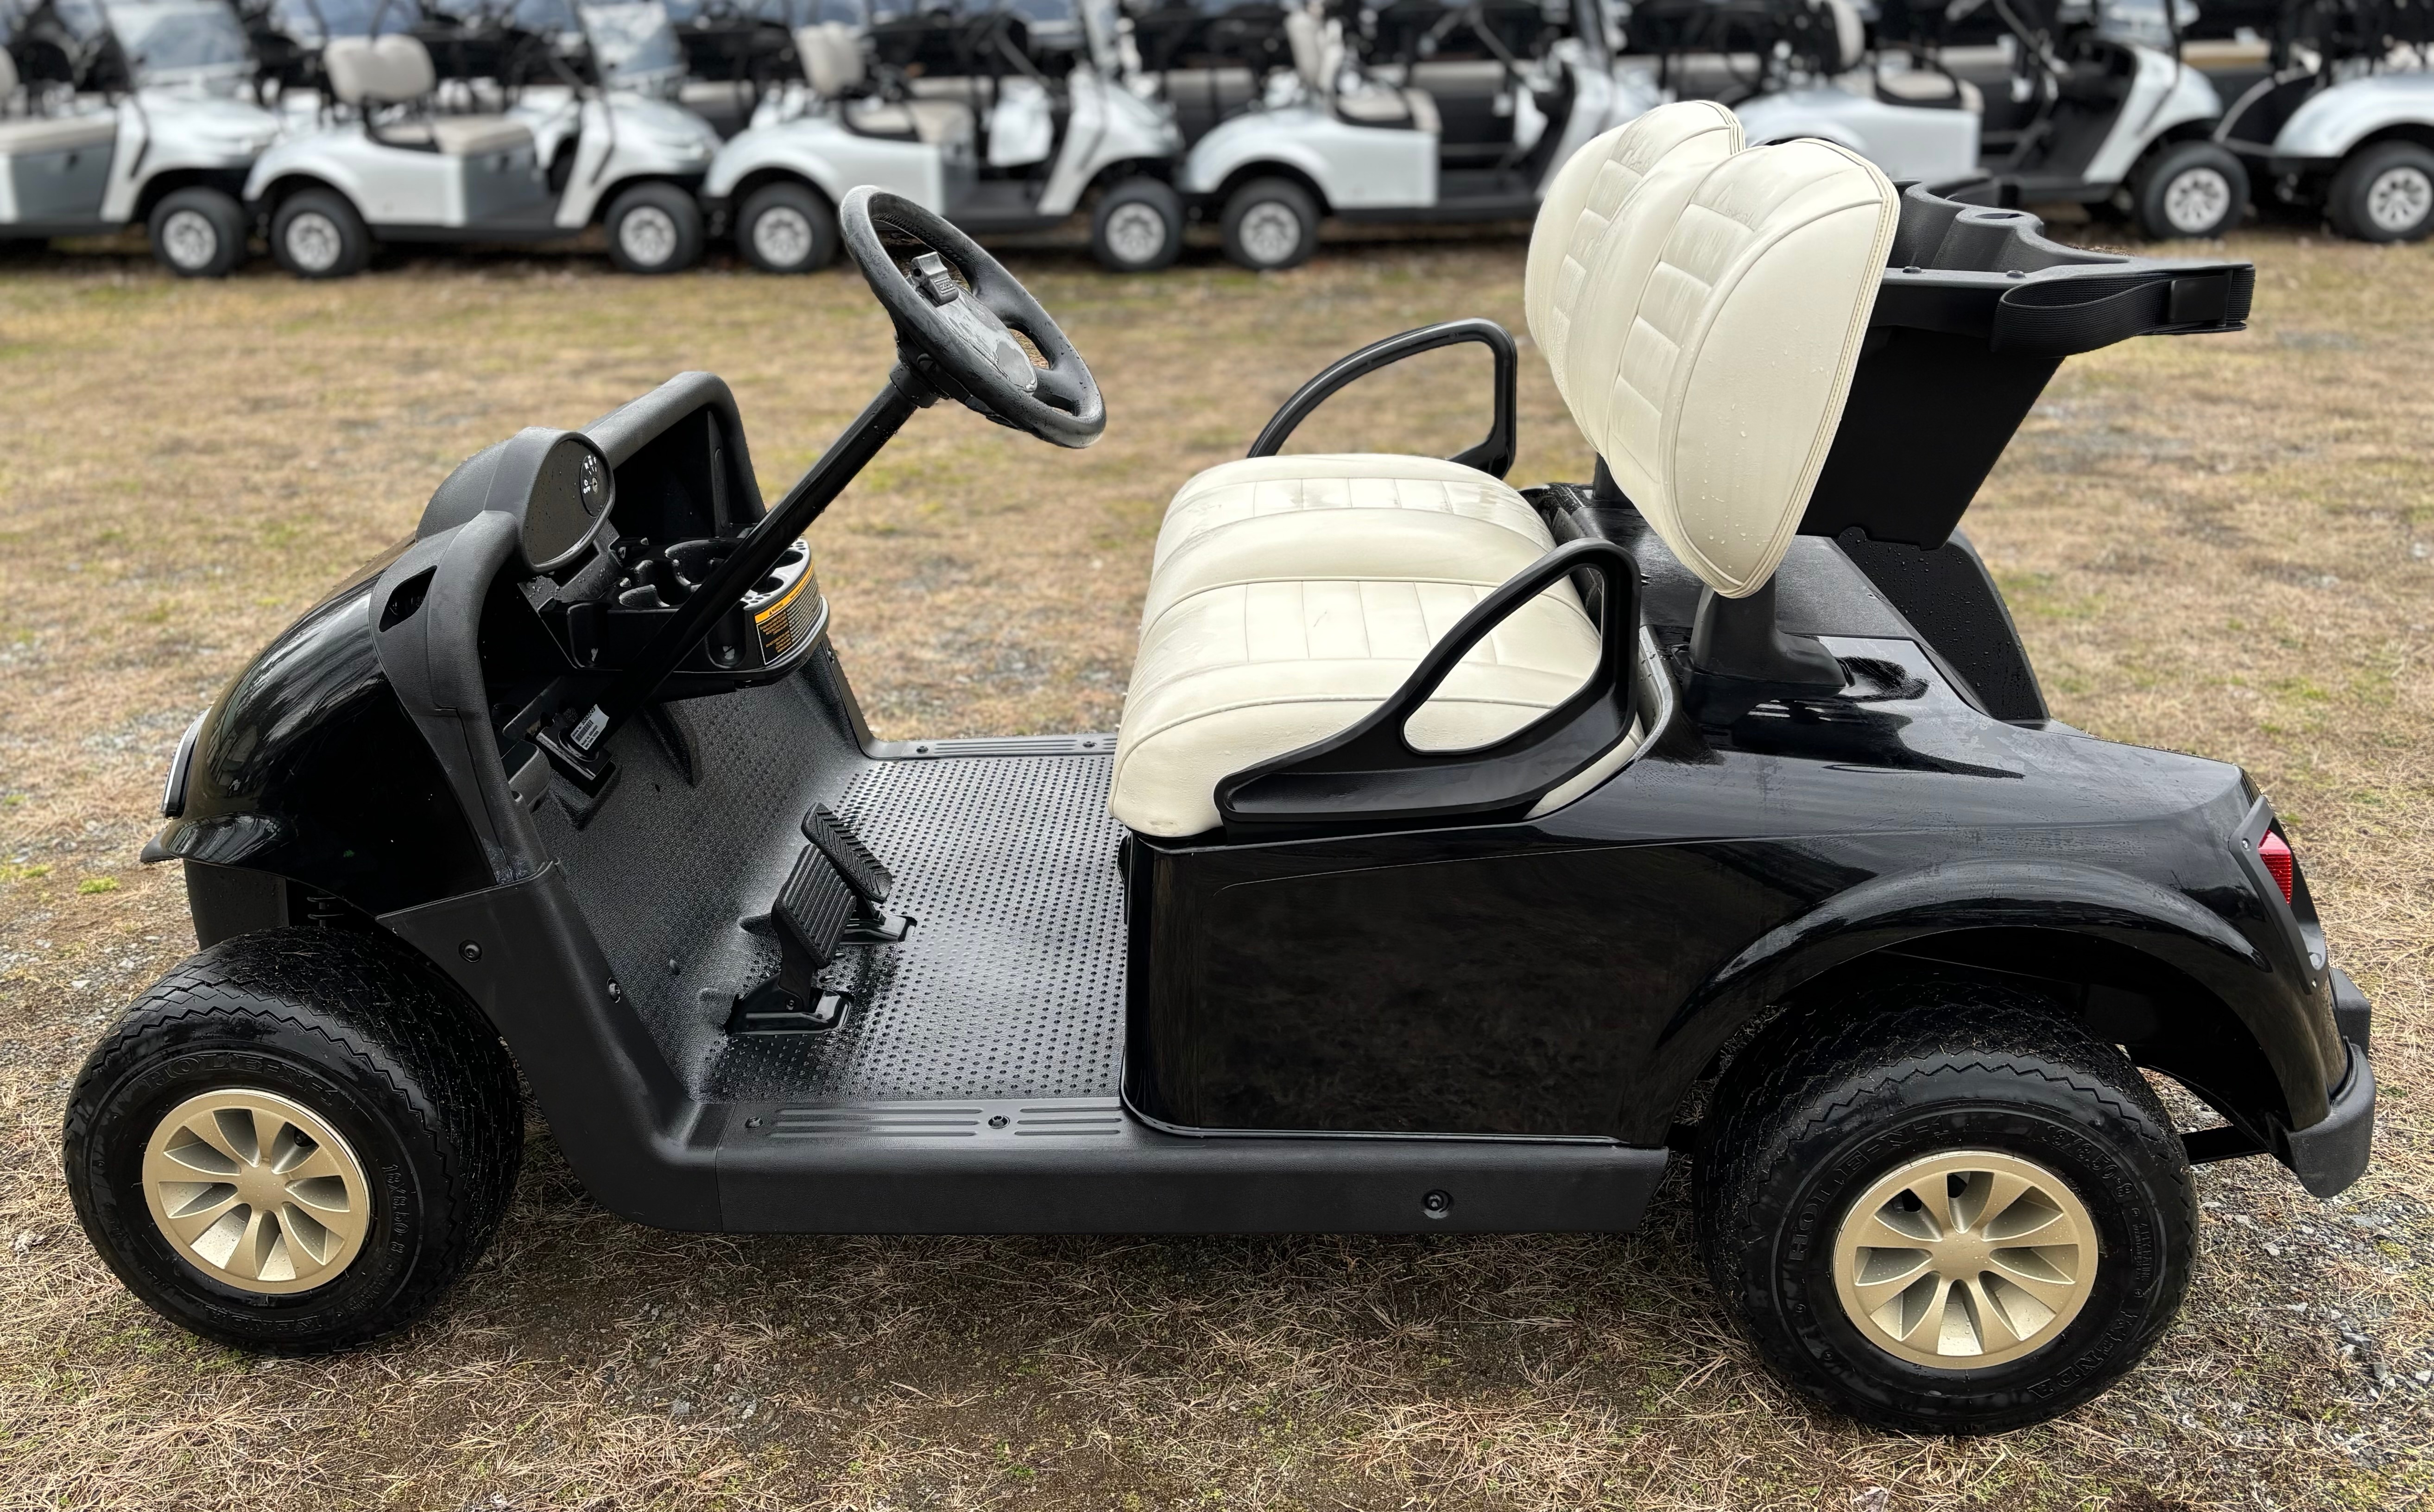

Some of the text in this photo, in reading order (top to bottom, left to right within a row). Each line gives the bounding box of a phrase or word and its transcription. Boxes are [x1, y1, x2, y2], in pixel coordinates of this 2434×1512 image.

[141, 1051, 341, 1107] HOLE-N-1
[1788, 1115, 1950, 1261] HOLE-N-1
[2026, 1310, 2139, 1399] KENDA
